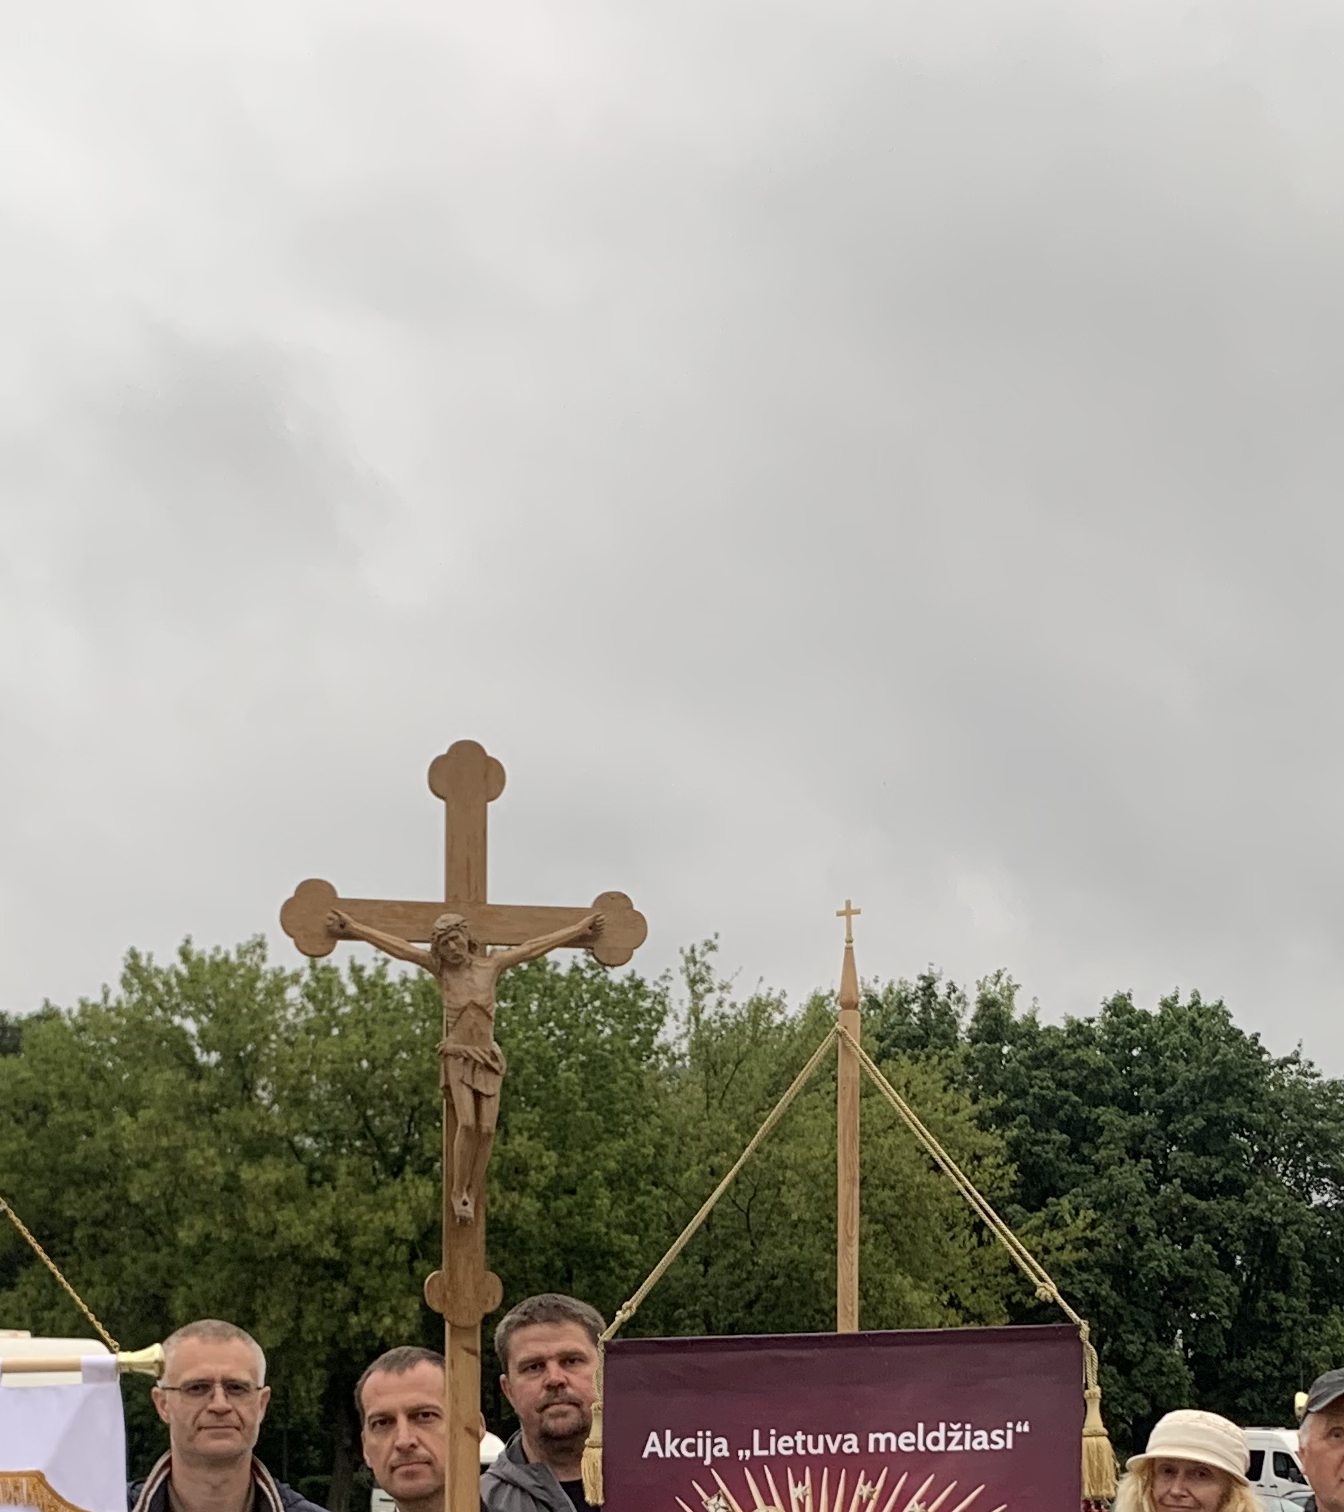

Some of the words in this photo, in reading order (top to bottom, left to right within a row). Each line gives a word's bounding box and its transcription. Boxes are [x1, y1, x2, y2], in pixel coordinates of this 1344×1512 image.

[642, 1429, 729, 1465] Akcija
[737, 1429, 859, 1461] „Lietuva
[868, 1421, 1030, 1453] meldžiasi“
